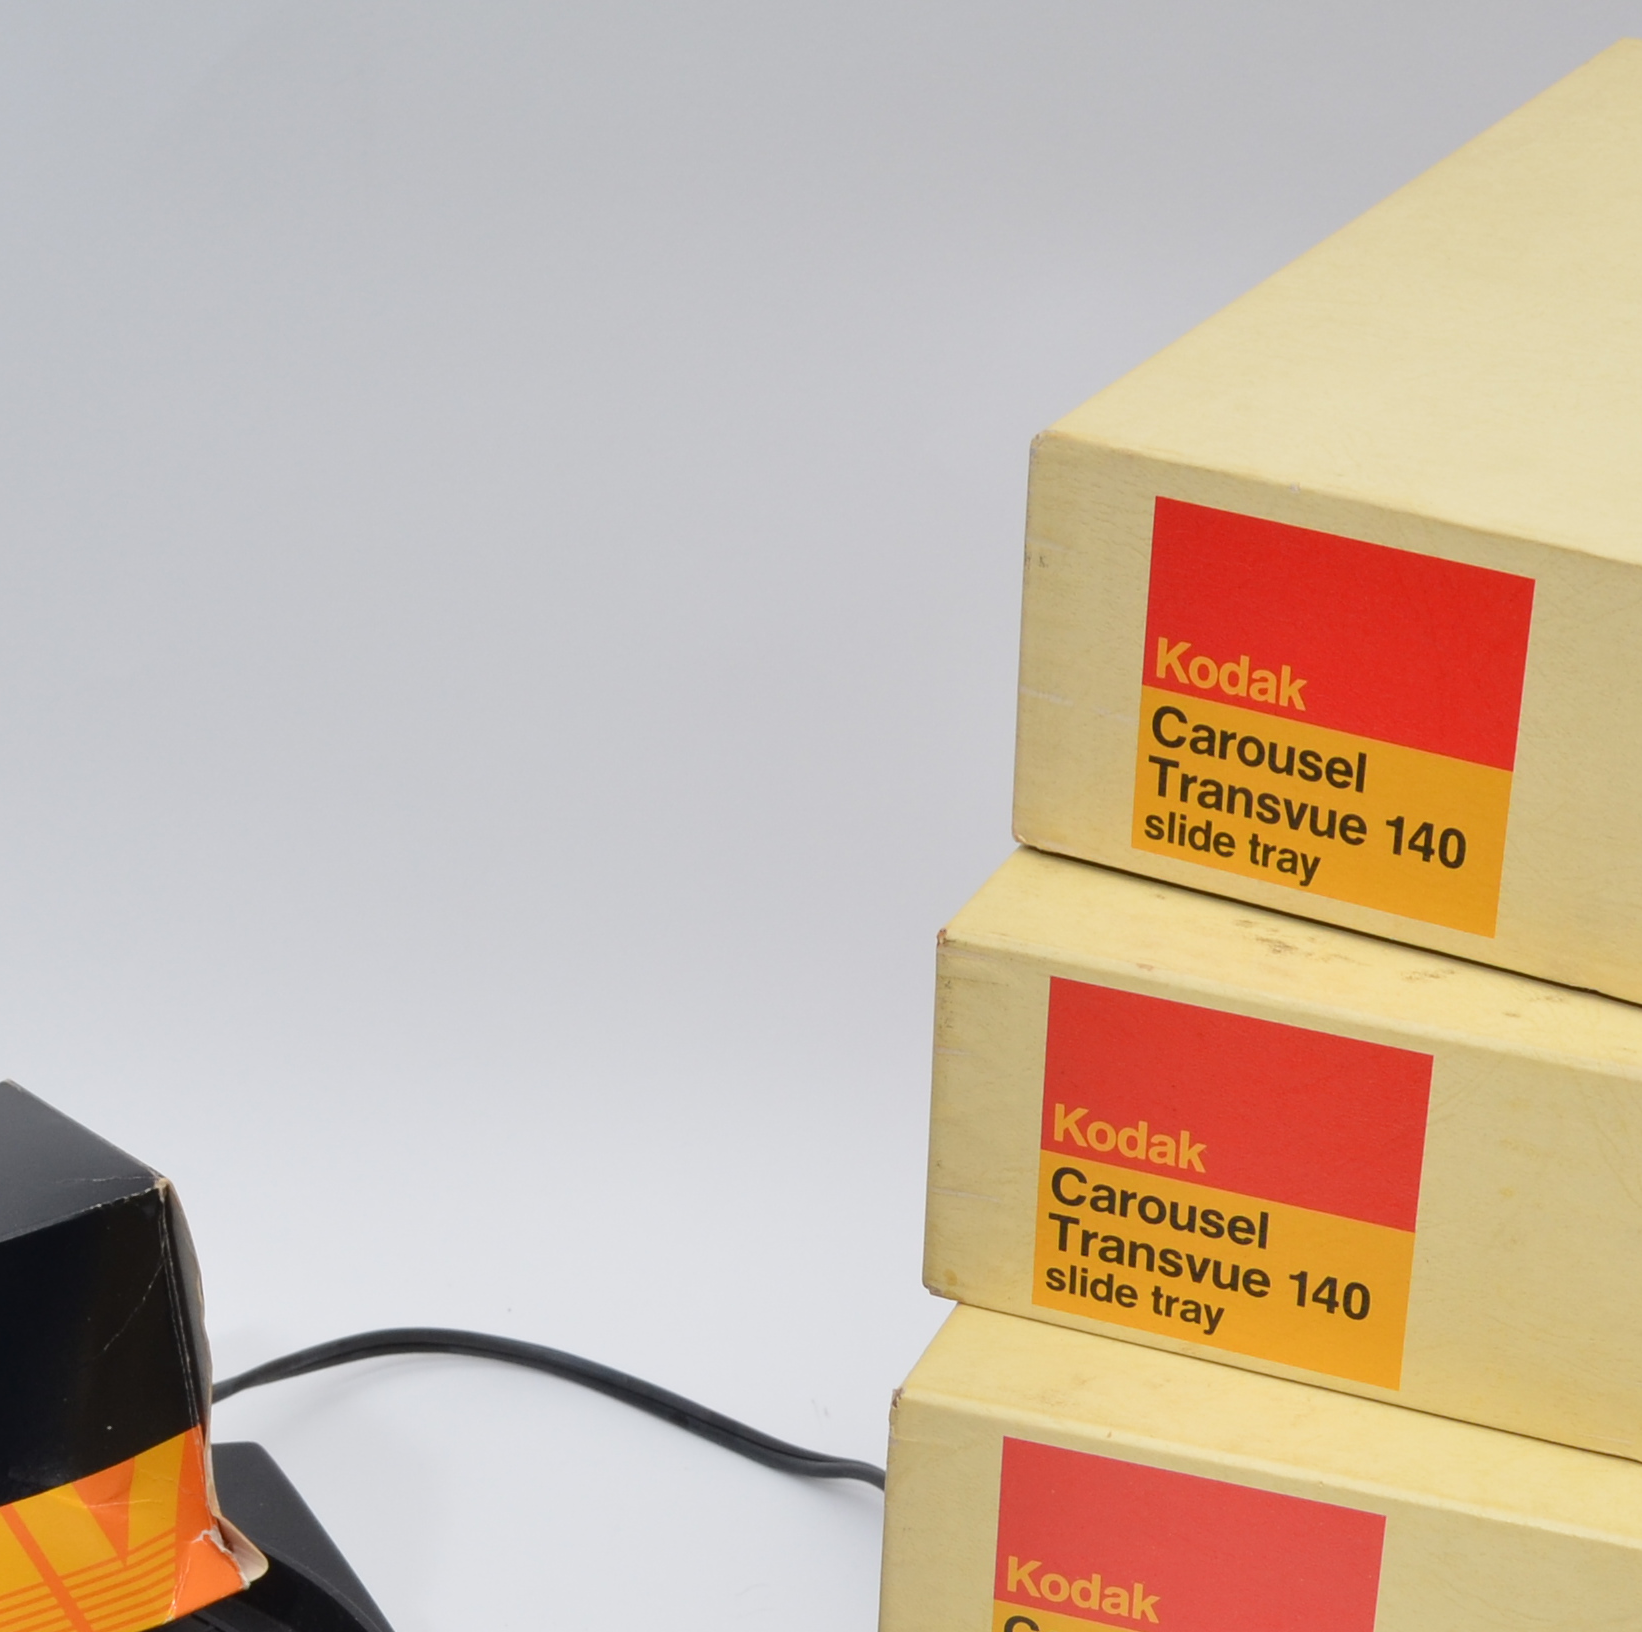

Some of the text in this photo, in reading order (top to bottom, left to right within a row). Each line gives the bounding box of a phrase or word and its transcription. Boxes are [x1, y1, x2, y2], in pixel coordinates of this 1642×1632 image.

[1156, 637, 1307, 711] Kodak
[1152, 706, 1367, 793] Carousel
[1144, 812, 1321, 886] slide tray
[1148, 756, 1466, 869] Transvue 140
[1054, 1103, 1207, 1173] Kodak
[1051, 1167, 1269, 1249] Carousel
[1045, 1265, 1225, 1335] slide tray
[1048, 1213, 1371, 1321] Transvue 140
[1007, 1556, 1160, 1624] Kodak
